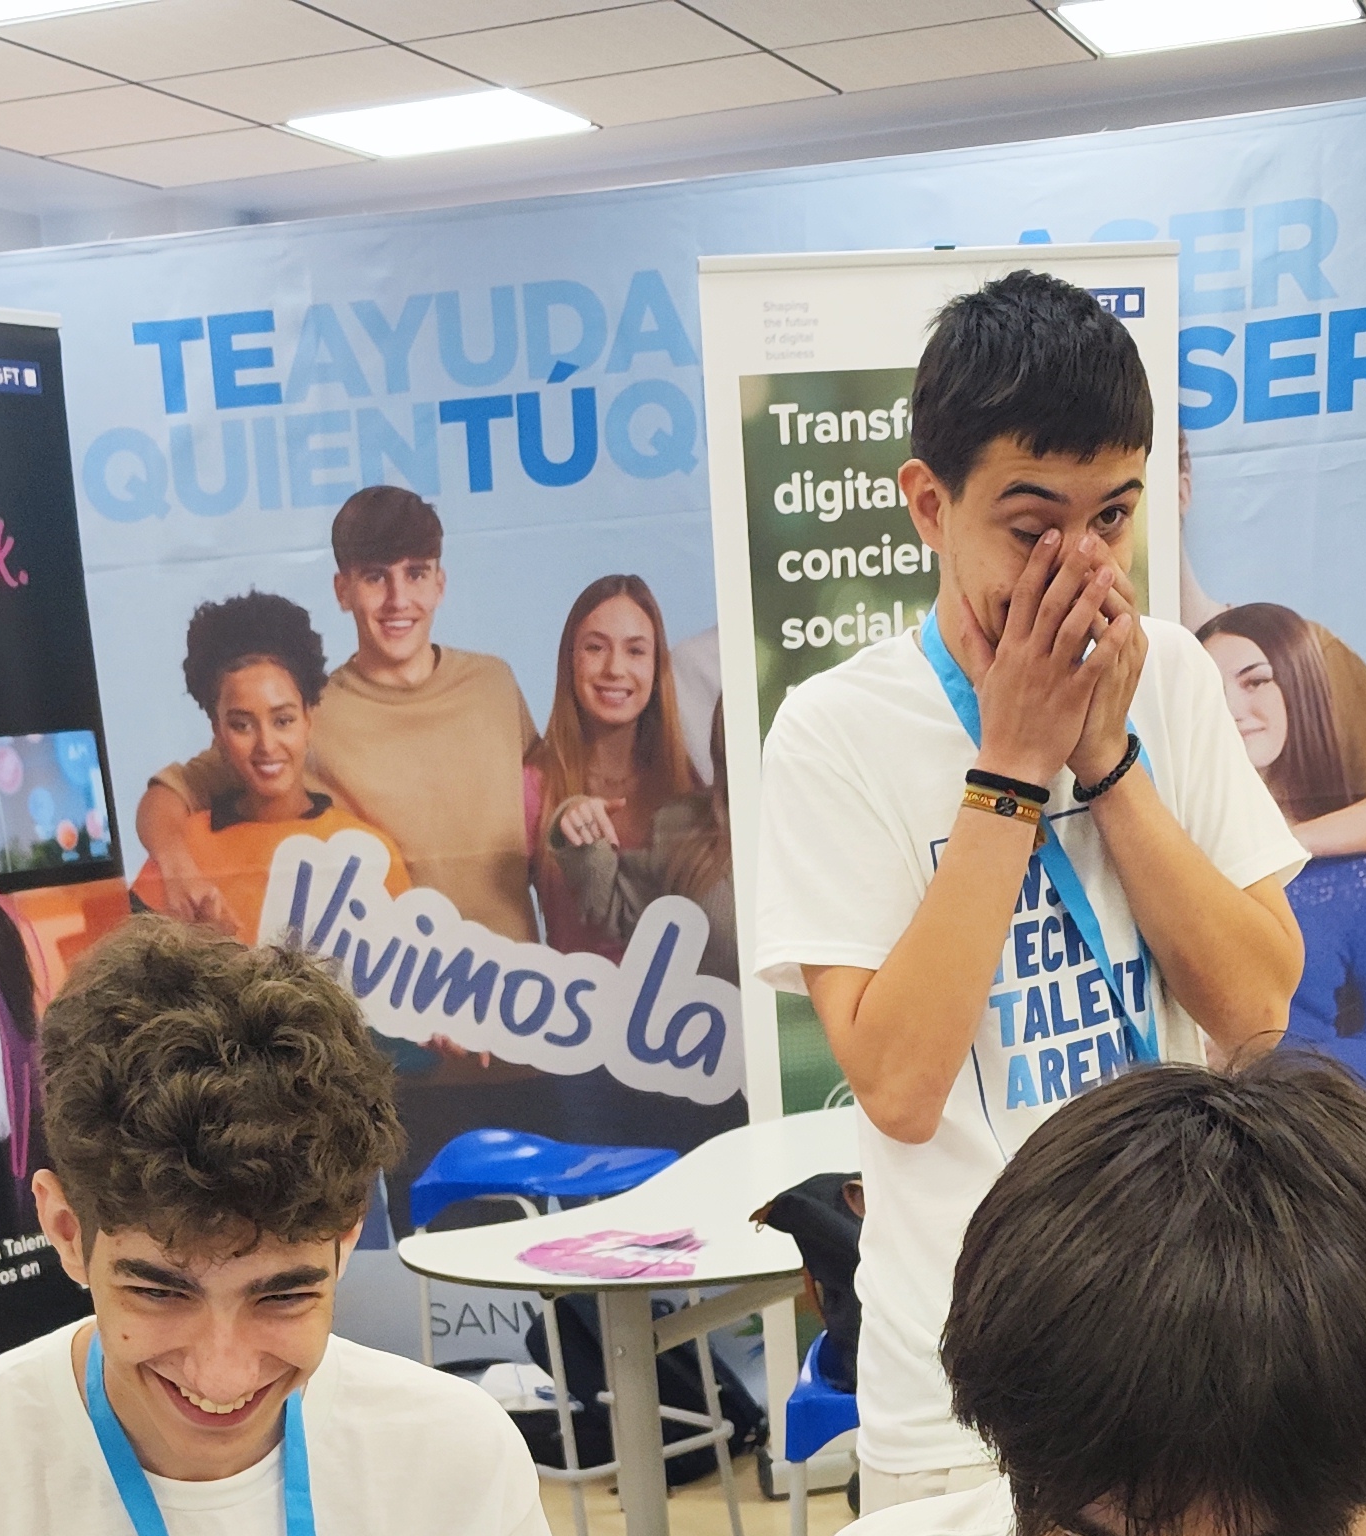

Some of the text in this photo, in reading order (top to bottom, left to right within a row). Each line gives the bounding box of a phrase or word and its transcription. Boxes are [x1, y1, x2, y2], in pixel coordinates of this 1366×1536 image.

[1096, 294, 1119, 313] FT
[768, 397, 913, 446] Transf
[781, 600, 903, 650] social
[288, 854, 727, 1077] Vivimos la
[989, 957, 1147, 1048] TALENT
[2, 1232, 53, 1258] Talen
[19, 1260, 42, 1280] en
